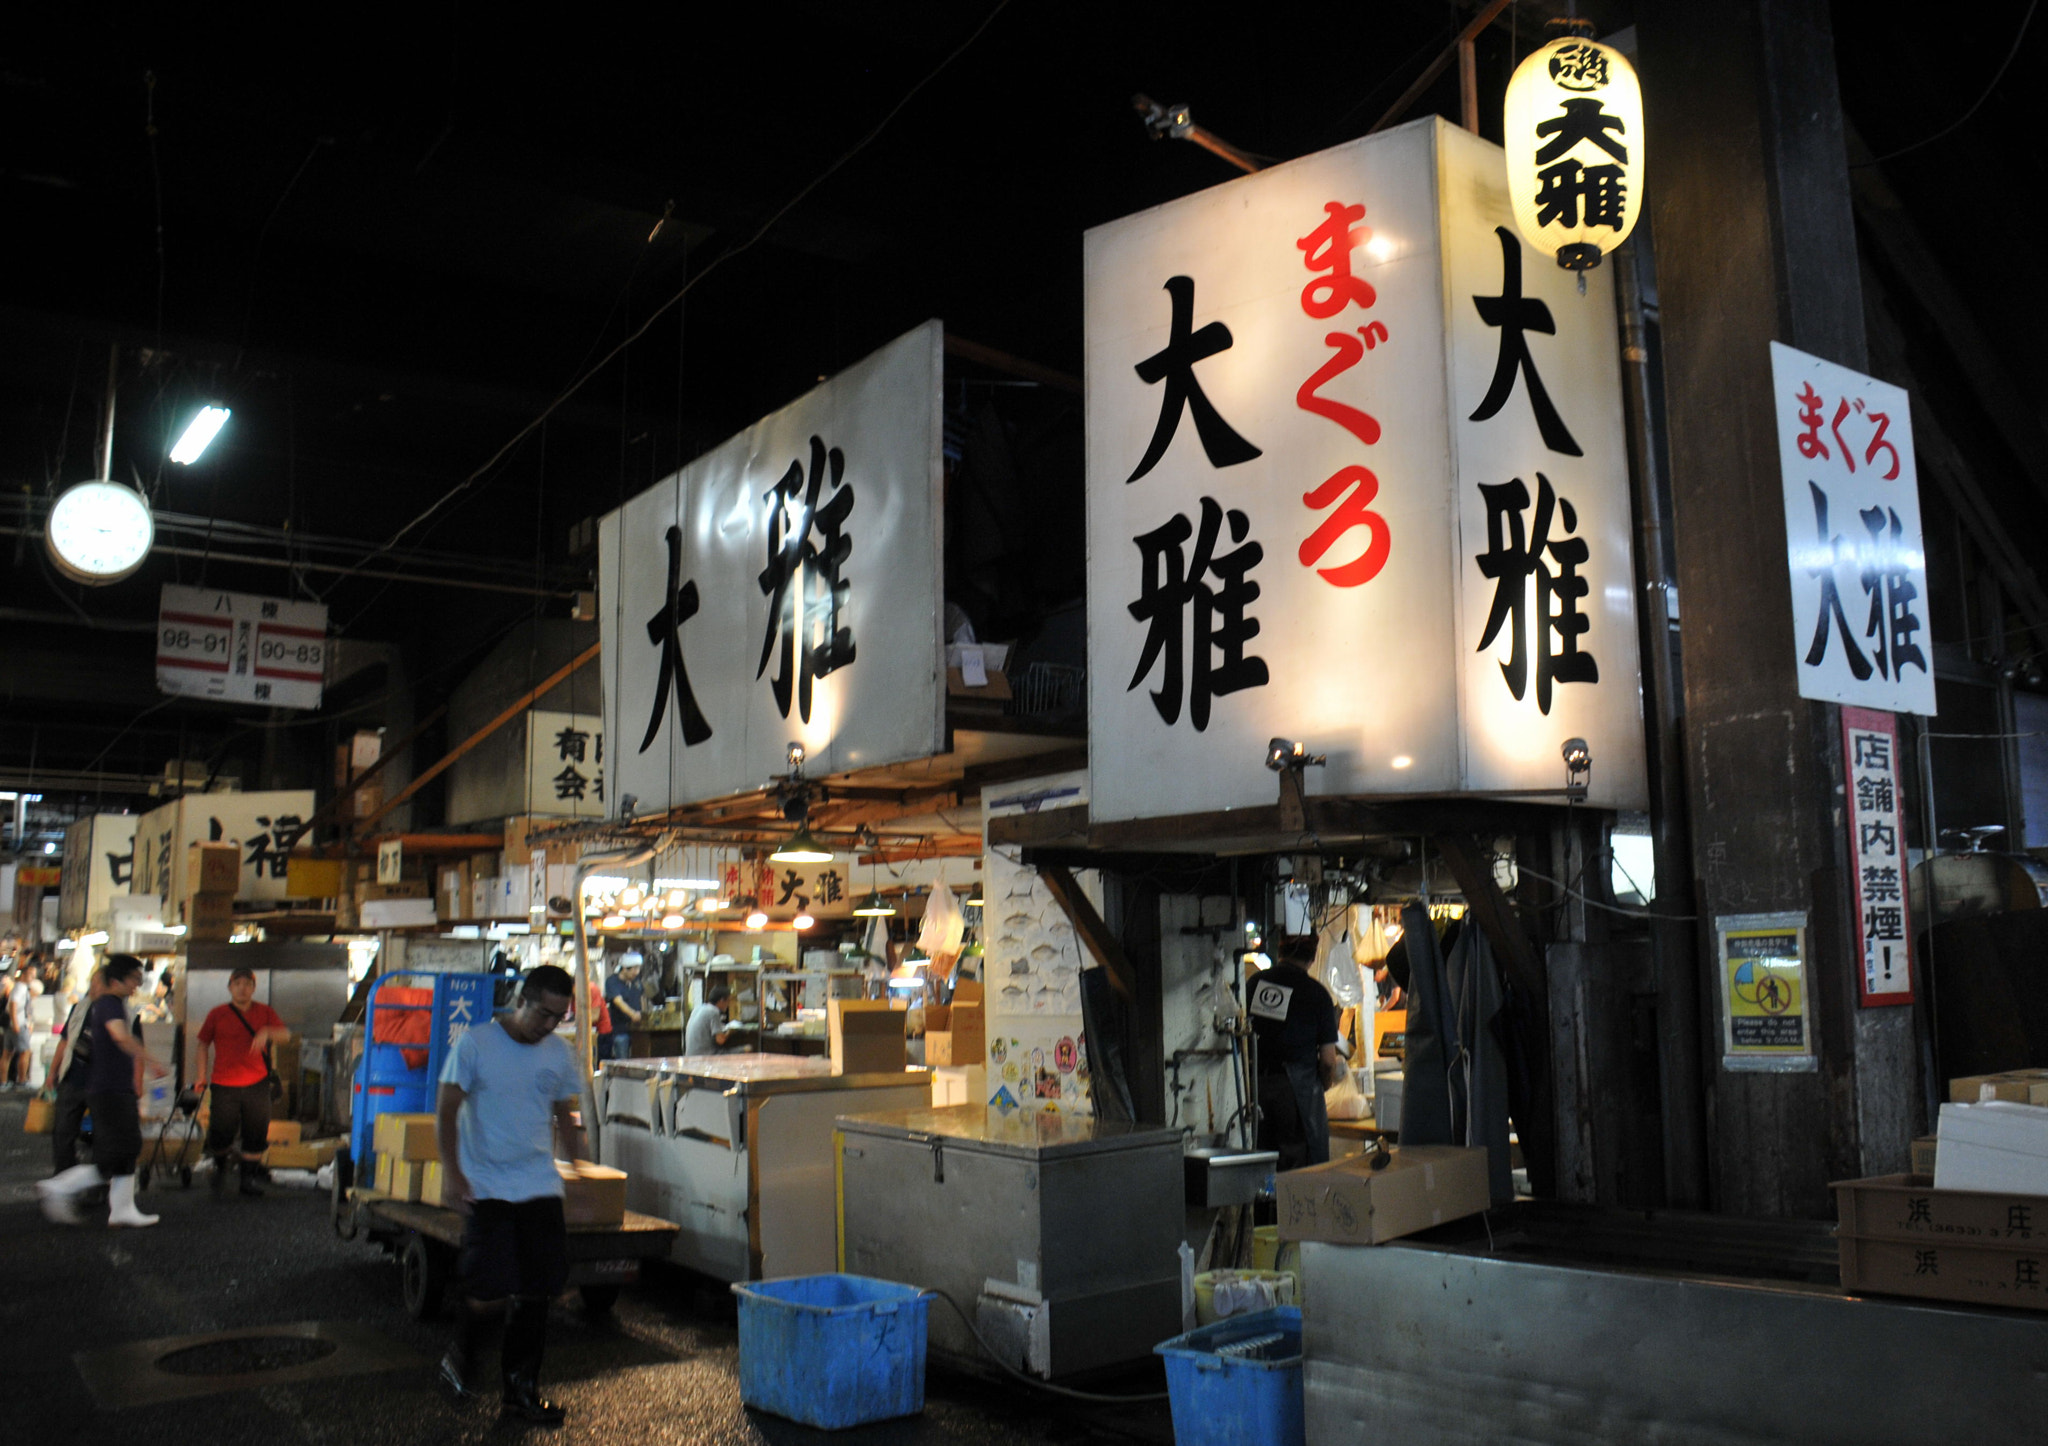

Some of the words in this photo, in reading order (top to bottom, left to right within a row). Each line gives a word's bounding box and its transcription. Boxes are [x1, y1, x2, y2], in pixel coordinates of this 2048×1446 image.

[1535, 97, 1628, 232] 大雅
[1296, 201, 1391, 587] まぐろ
[1795, 381, 1900, 481] まぐろ
[1126, 275, 1270, 732] 大雅
[1468, 226, 1599, 716] 大雅
[163, 628, 227, 654] 98-91
[638, 434, 857, 754] 大雅
[1804, 479, 1928, 684] 大雅
[261, 640, 321, 665] 90-83
[1908, 1198, 1931, 1223] 浜
[1915, 1250, 1938, 1275] 浜
